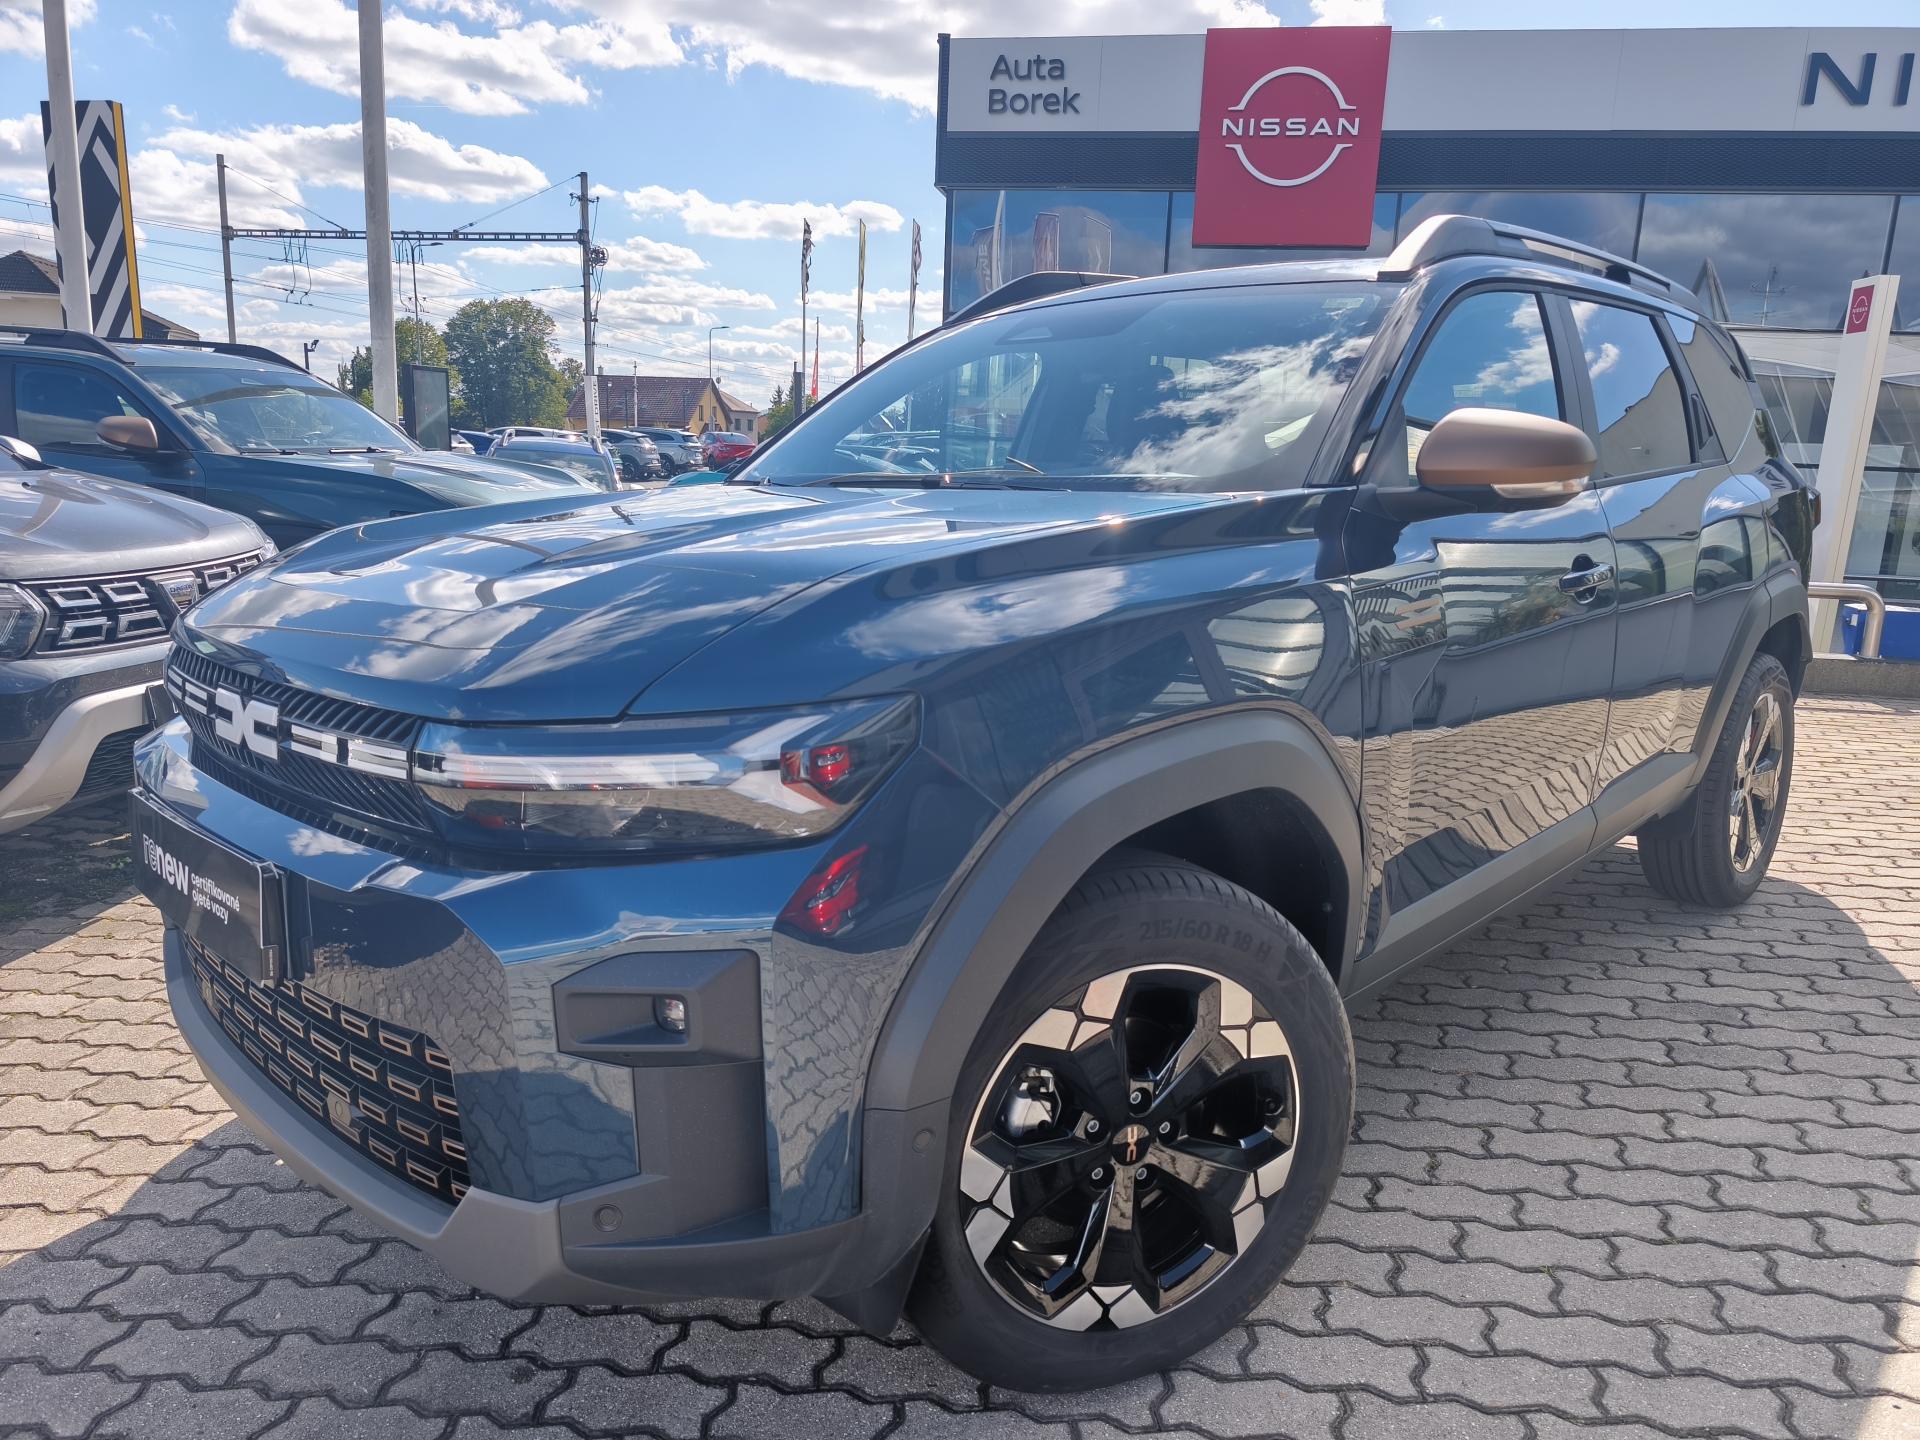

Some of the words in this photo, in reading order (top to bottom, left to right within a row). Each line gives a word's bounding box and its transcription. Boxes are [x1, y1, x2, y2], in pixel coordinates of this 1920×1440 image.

[990, 54, 1065, 81] Auta
[1800, 52, 1915, 106] NI
[988, 86, 1081, 114] Borek
[1221, 117, 1361, 137] NISSAN
[143, 833, 189, 896] renew
[191, 873, 240, 912] certifikované
[192, 889, 212, 910] ojeté
[210, 900, 229, 925] vozy
[1139, 917, 1212, 943] 215/60
[1214, 923, 1230, 946] R
[1231, 929, 1254, 953] 18
